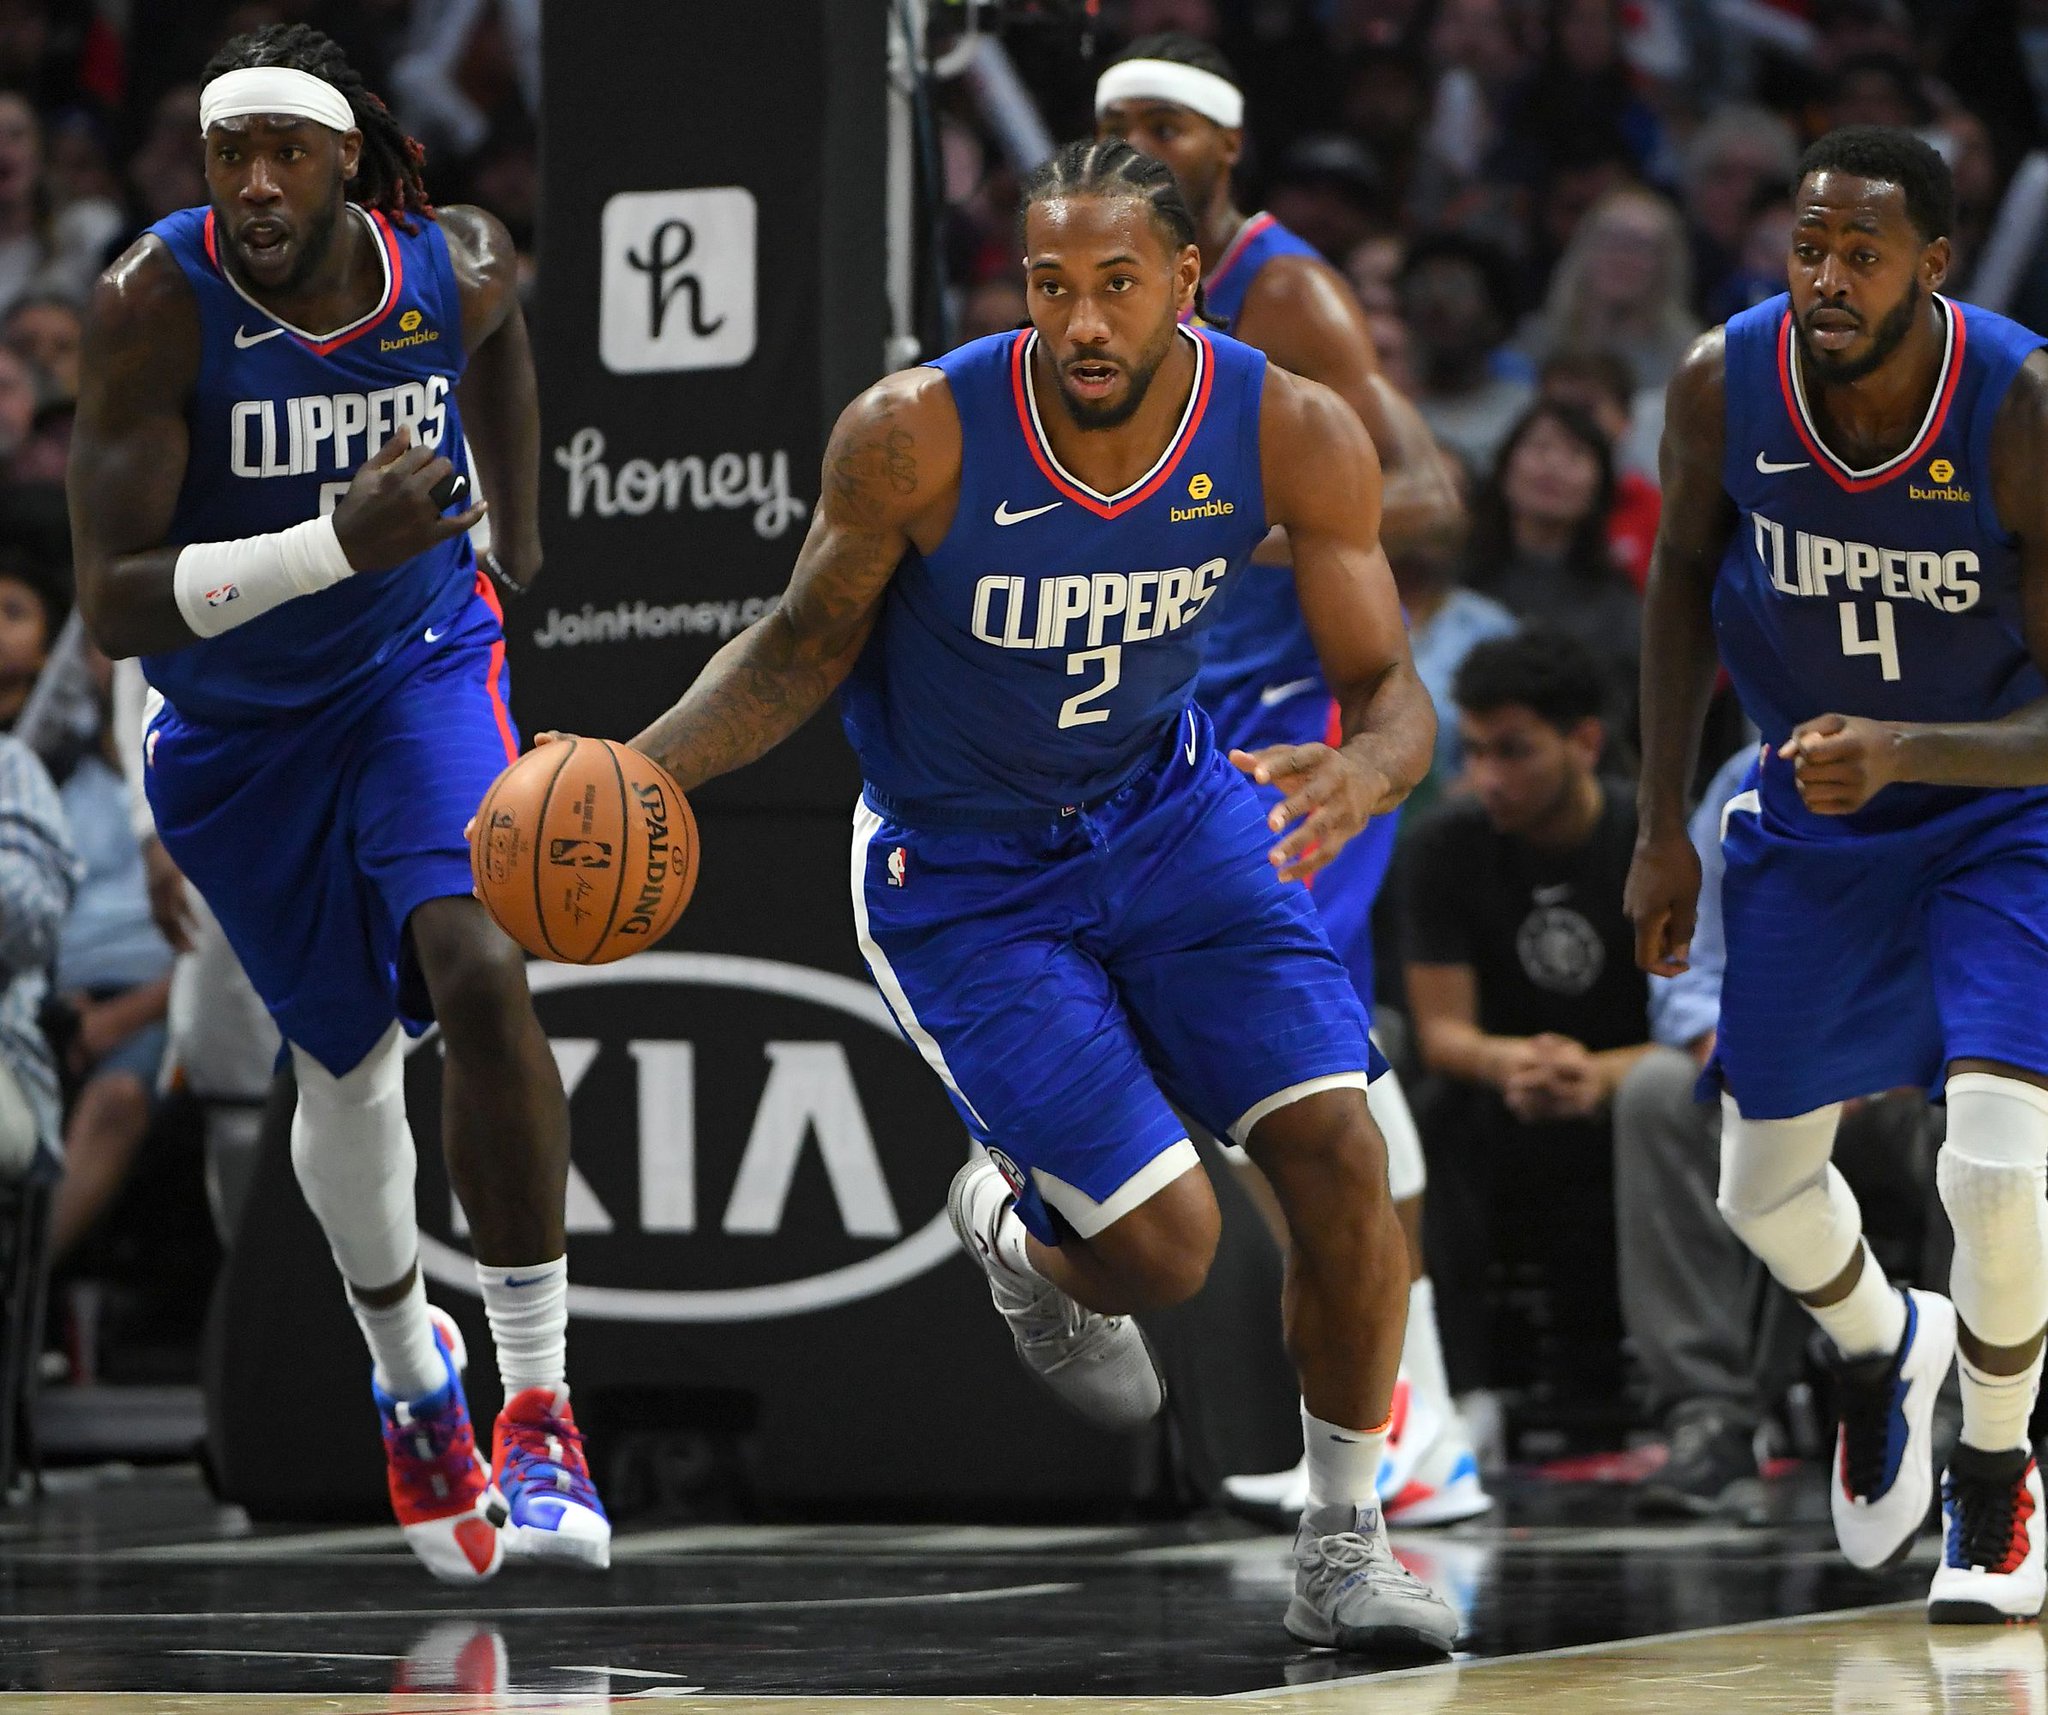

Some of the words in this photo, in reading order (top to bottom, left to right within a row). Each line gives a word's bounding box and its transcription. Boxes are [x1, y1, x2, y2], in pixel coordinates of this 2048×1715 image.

[380, 329, 439, 352] bumble
[231, 374, 450, 479] CLIPPERS
[554, 426, 808, 540] honey
[1170, 499, 1235, 523] bumble
[1909, 484, 1972, 502] bumble
[971, 557, 1228, 650] CLIPPERS
[1838, 600, 1901, 682] 4
[1057, 645, 1122, 730] 2
[619, 781, 669, 935] SPALDING
[437, 1036, 901, 1237] IA
